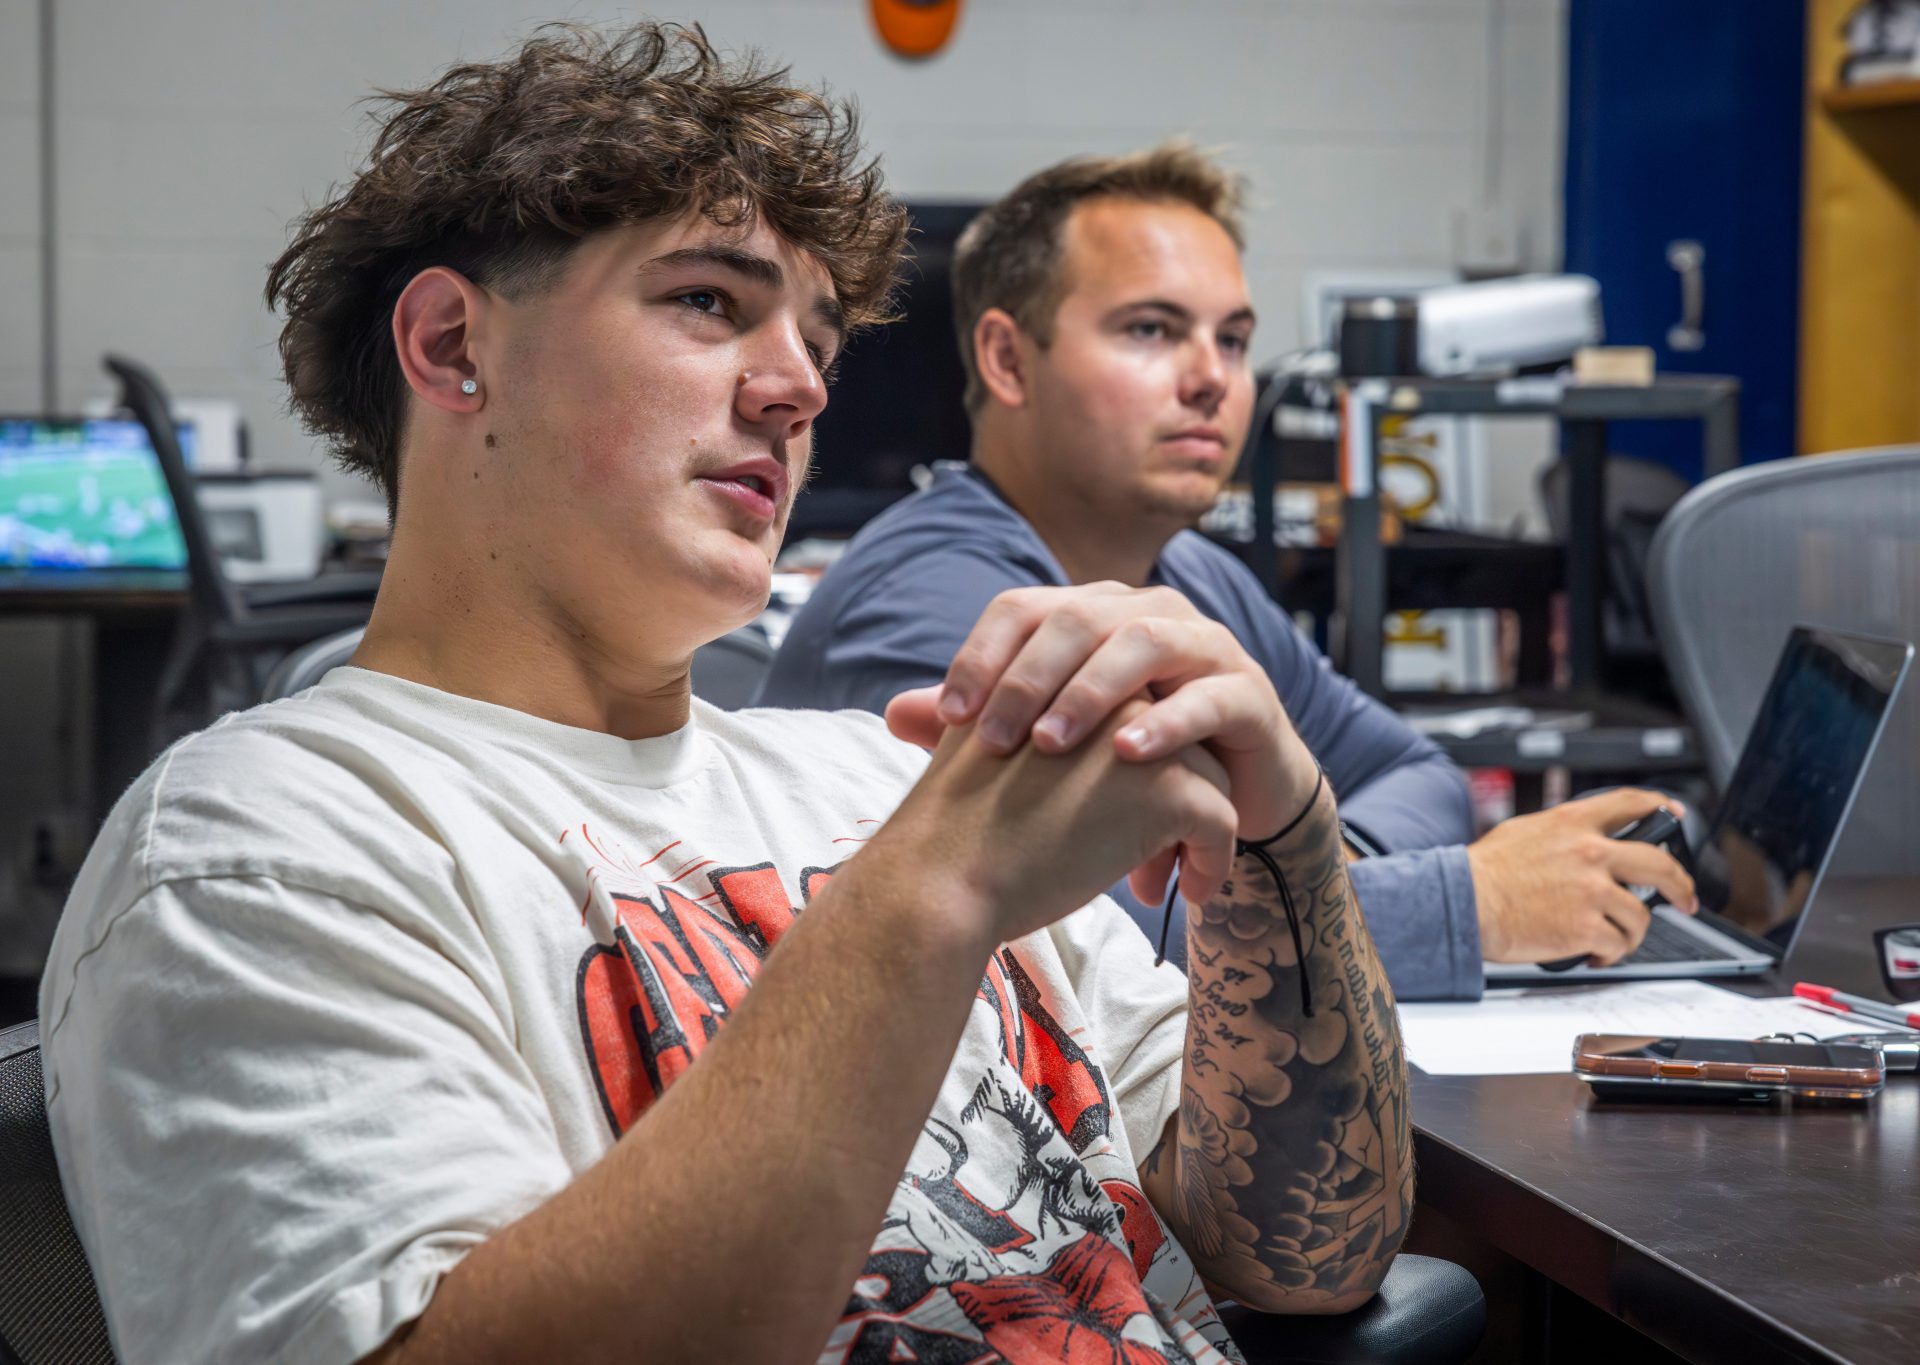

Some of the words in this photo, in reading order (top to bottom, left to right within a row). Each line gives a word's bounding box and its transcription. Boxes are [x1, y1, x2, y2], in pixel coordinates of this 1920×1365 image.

[1222, 966, 1255, 987] is
[1338, 940, 1370, 1023] matter
[1363, 1022, 1391, 1092] what
[1214, 1021, 1254, 1050] in
